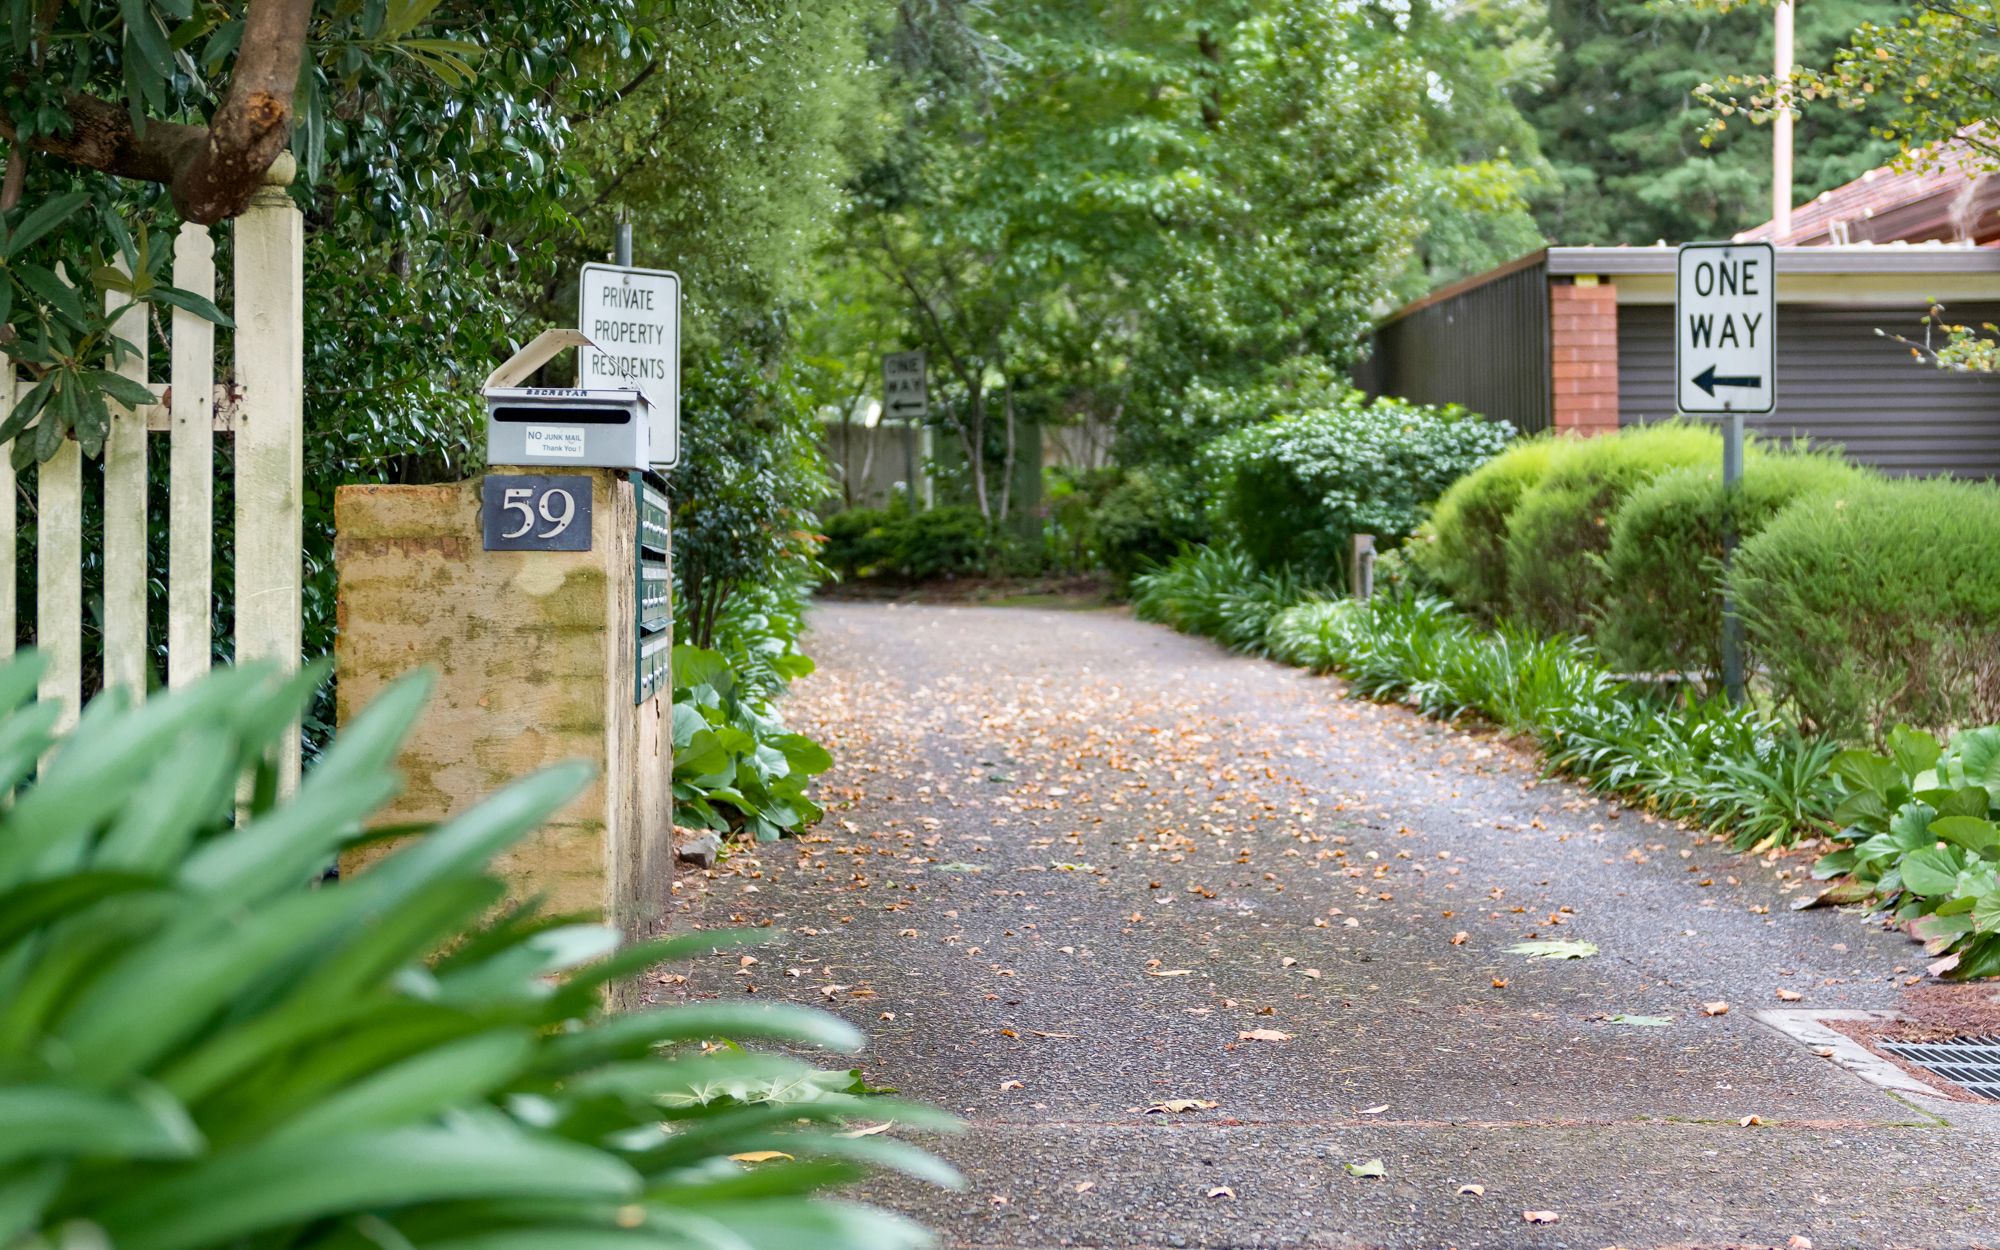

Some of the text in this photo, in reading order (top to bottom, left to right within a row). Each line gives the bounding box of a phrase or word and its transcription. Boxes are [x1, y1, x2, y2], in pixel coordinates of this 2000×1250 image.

[1695, 260, 1759, 297] ONE
[602, 286, 654, 311] PRIVATE
[594, 319, 664, 345] PROPERTY
[1690, 313, 1762, 349] WAY
[592, 354, 665, 380] RESIDENTS
[528, 431, 542, 440] NO
[542, 444, 563, 452] Thank
[501, 488, 575, 539] 59
